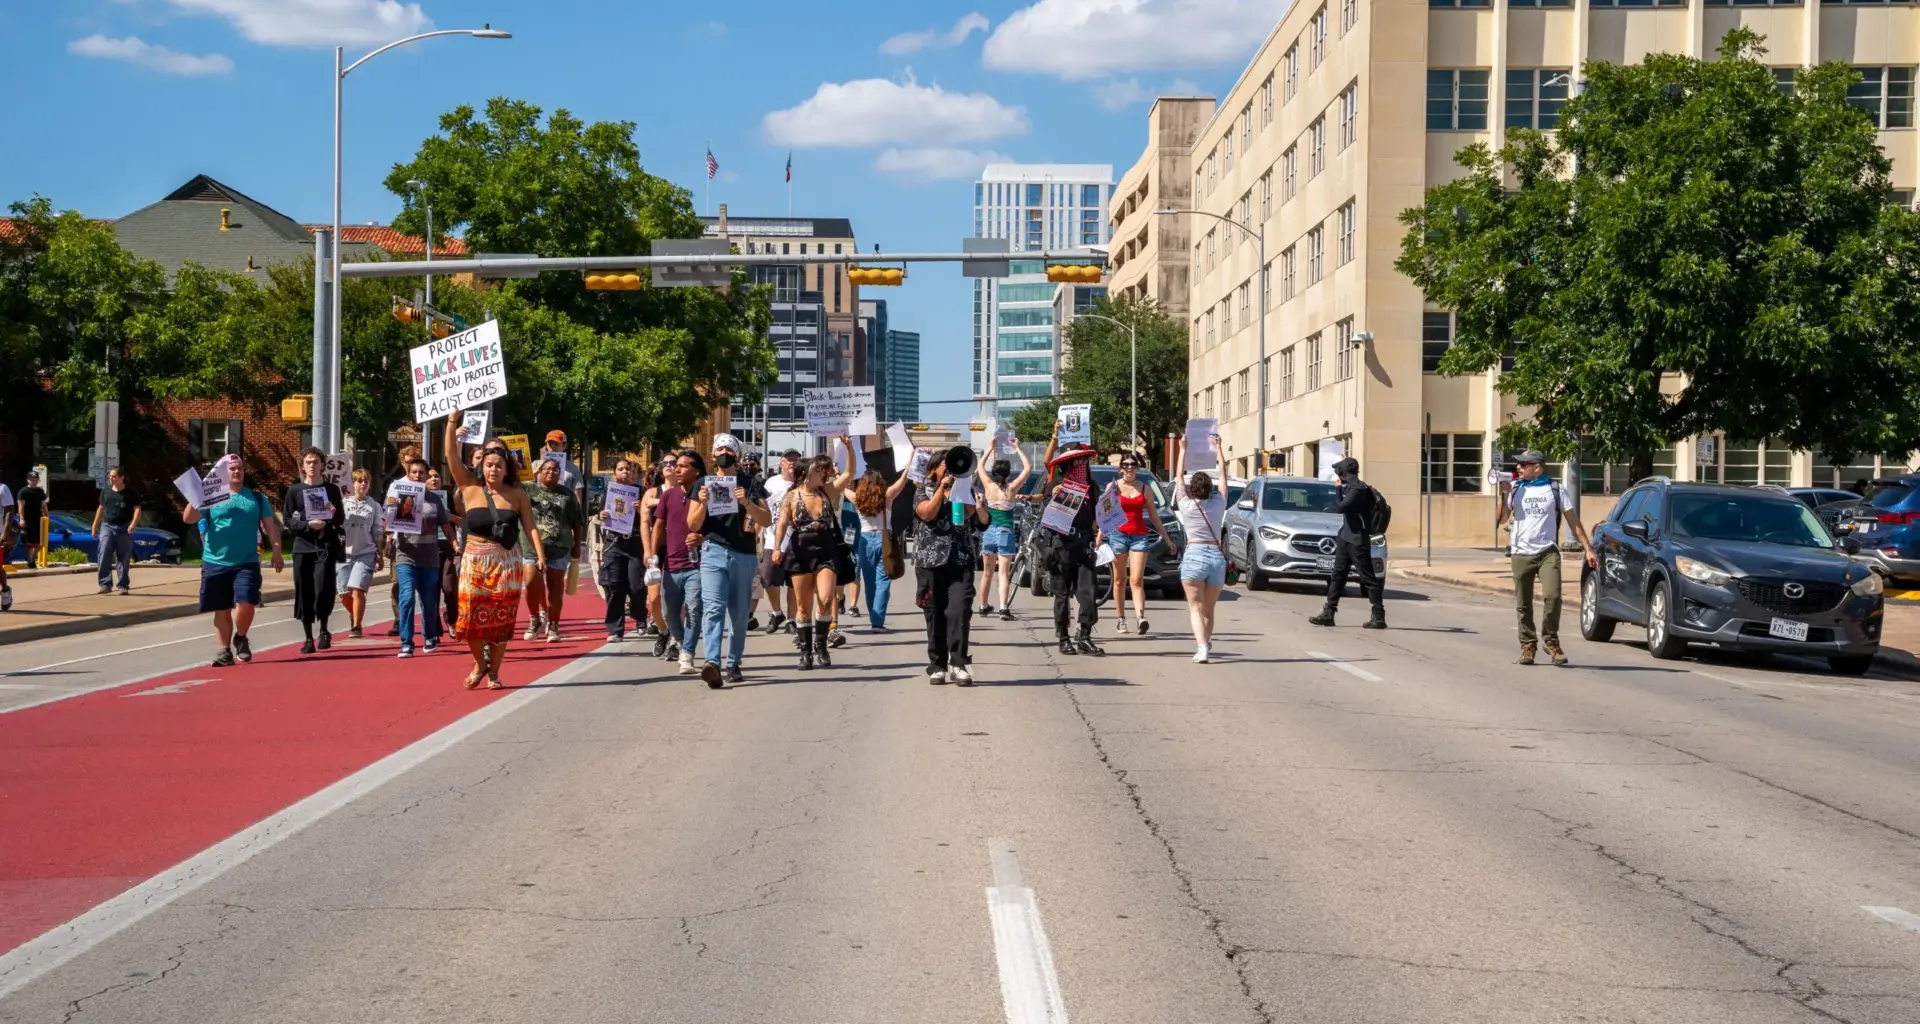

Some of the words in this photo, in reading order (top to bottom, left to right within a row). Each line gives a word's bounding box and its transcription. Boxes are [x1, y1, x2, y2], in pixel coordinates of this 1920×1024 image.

[429, 328, 478, 359] PROTECT
[414, 355, 457, 384] BLACK
[460, 342, 498, 369] LIVES
[417, 383, 438, 400] LIKE
[442, 376, 460, 391] YOU
[464, 361, 502, 383] PROTECT
[420, 392, 463, 419] RACIST
[467, 381, 497, 402] COPS
[326, 459, 345, 471] ST
[201, 478, 222, 487] KILLER
[322, 474, 340, 484] NE
[203, 485, 222, 497] COPS!
[394, 484, 413, 492] JUSTICE
[414, 485, 424, 493] FOR
[608, 487, 627, 496] JUSTICE
